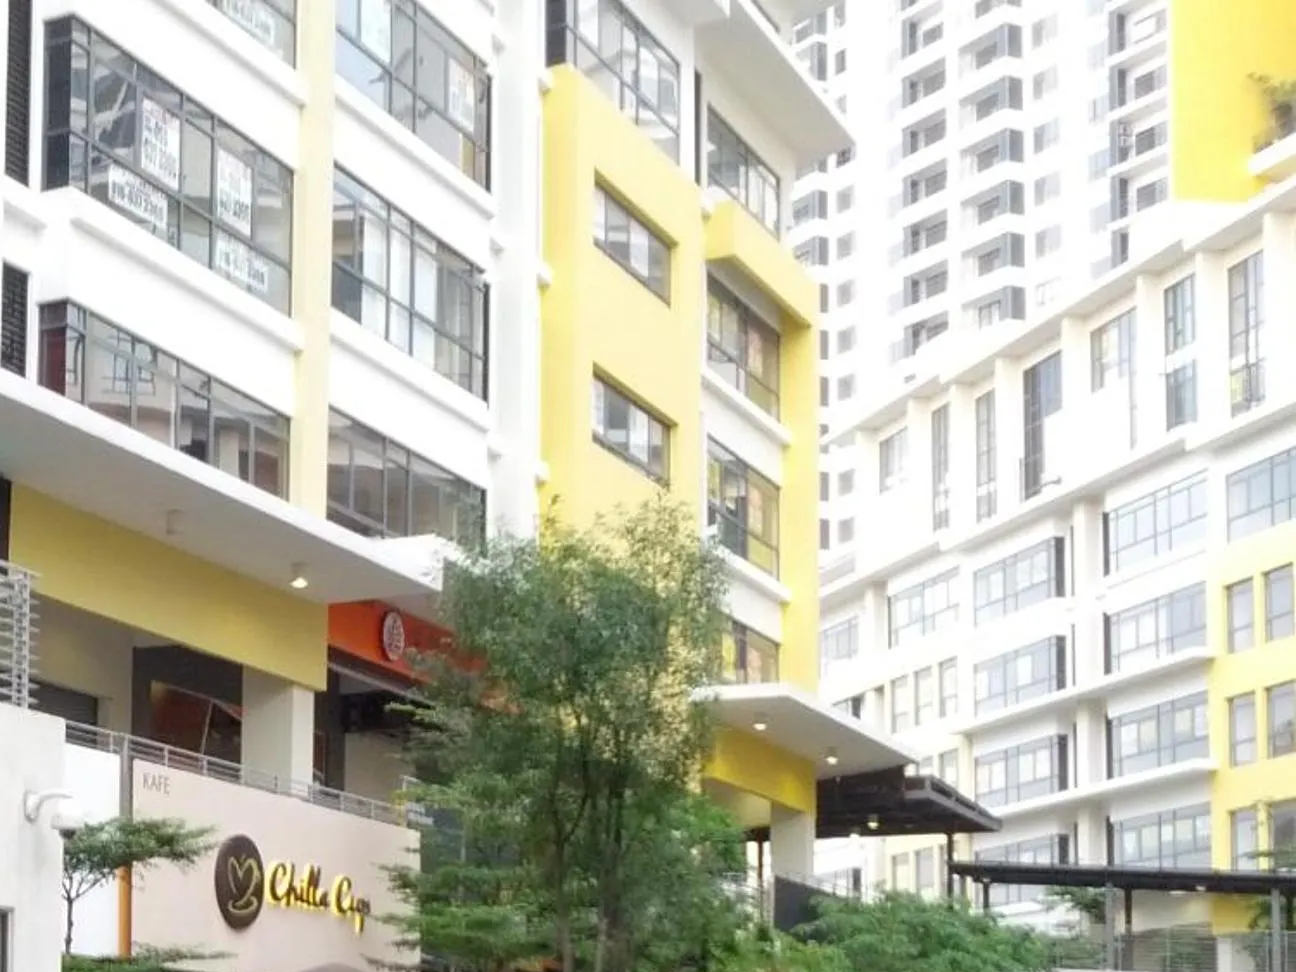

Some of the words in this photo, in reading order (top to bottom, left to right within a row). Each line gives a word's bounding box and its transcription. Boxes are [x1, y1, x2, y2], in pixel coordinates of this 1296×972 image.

[142, 771, 171, 797] KAFE
[266, 861, 329, 911] Chilla
[333, 875, 371, 936] Cup
